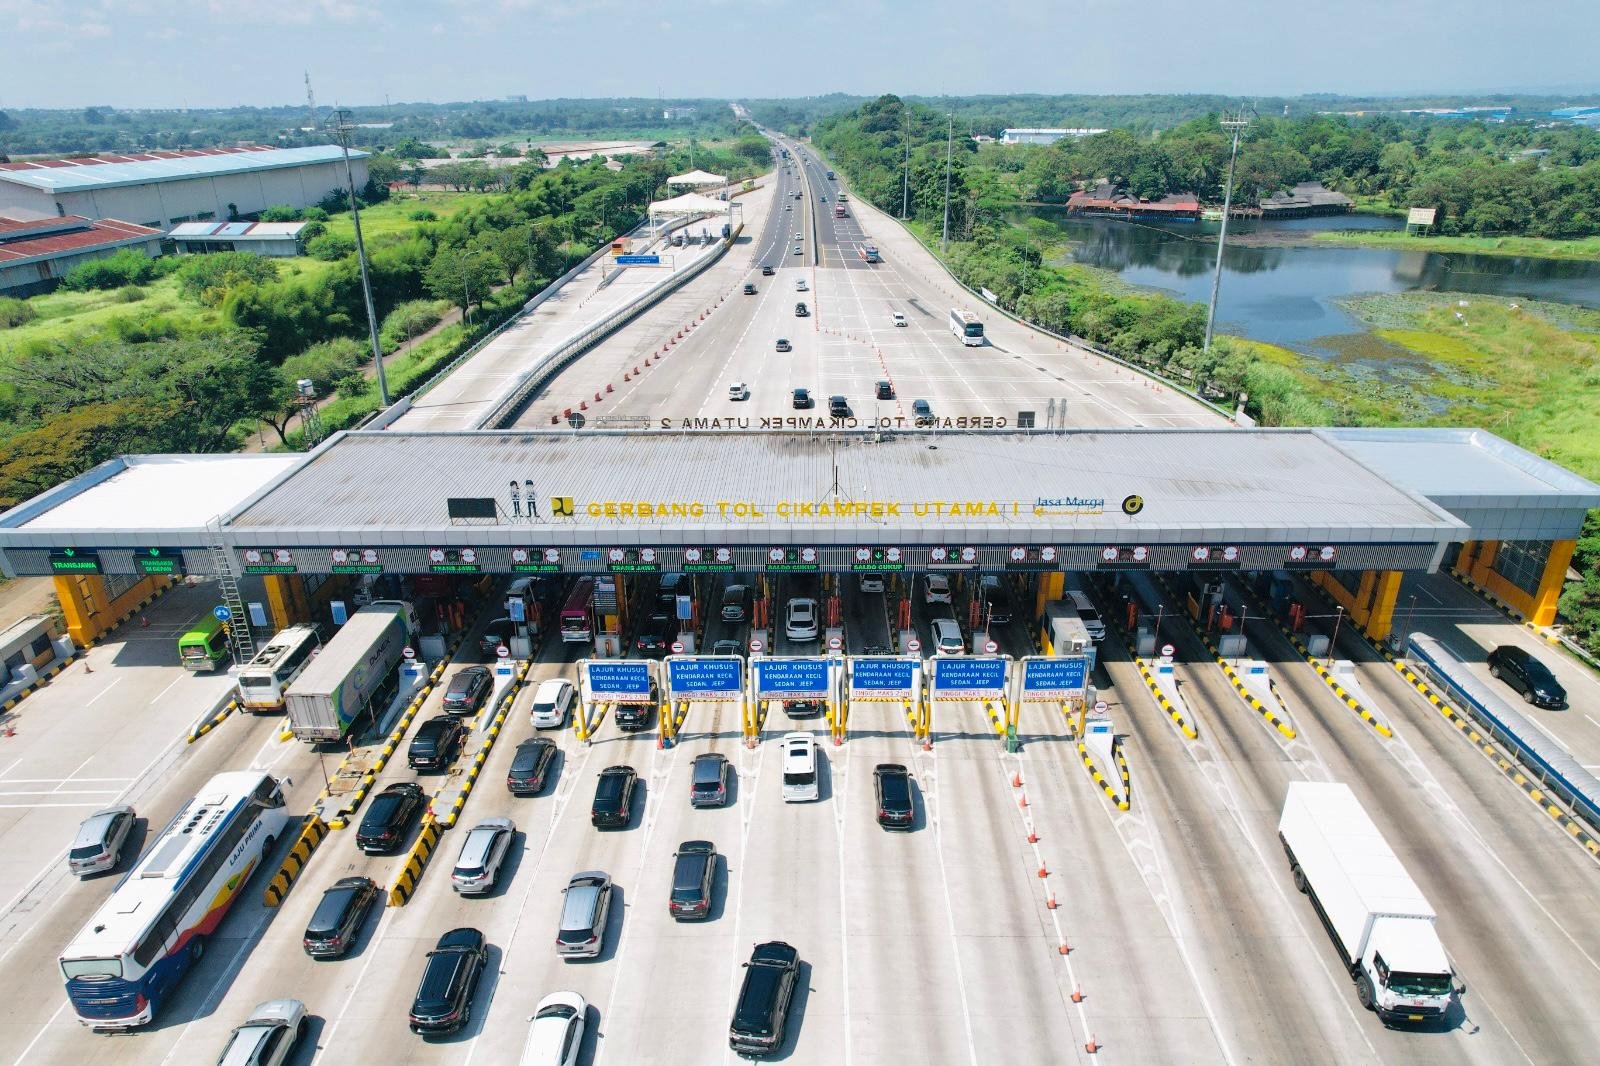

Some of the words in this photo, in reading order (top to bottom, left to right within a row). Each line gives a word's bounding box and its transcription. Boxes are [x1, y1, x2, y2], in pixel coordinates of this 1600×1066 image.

[587, 501, 704, 517] GERBANG
[717, 501, 764, 517] TOL
[776, 500, 901, 517] CIKAMPEK
[913, 501, 1000, 517] UTAMA
[1037, 497, 1062, 507] Jasa
[1066, 496, 1104, 508] Marga
[229, 843, 245, 867] LAJU
[244, 819, 263, 846] PRIMA
